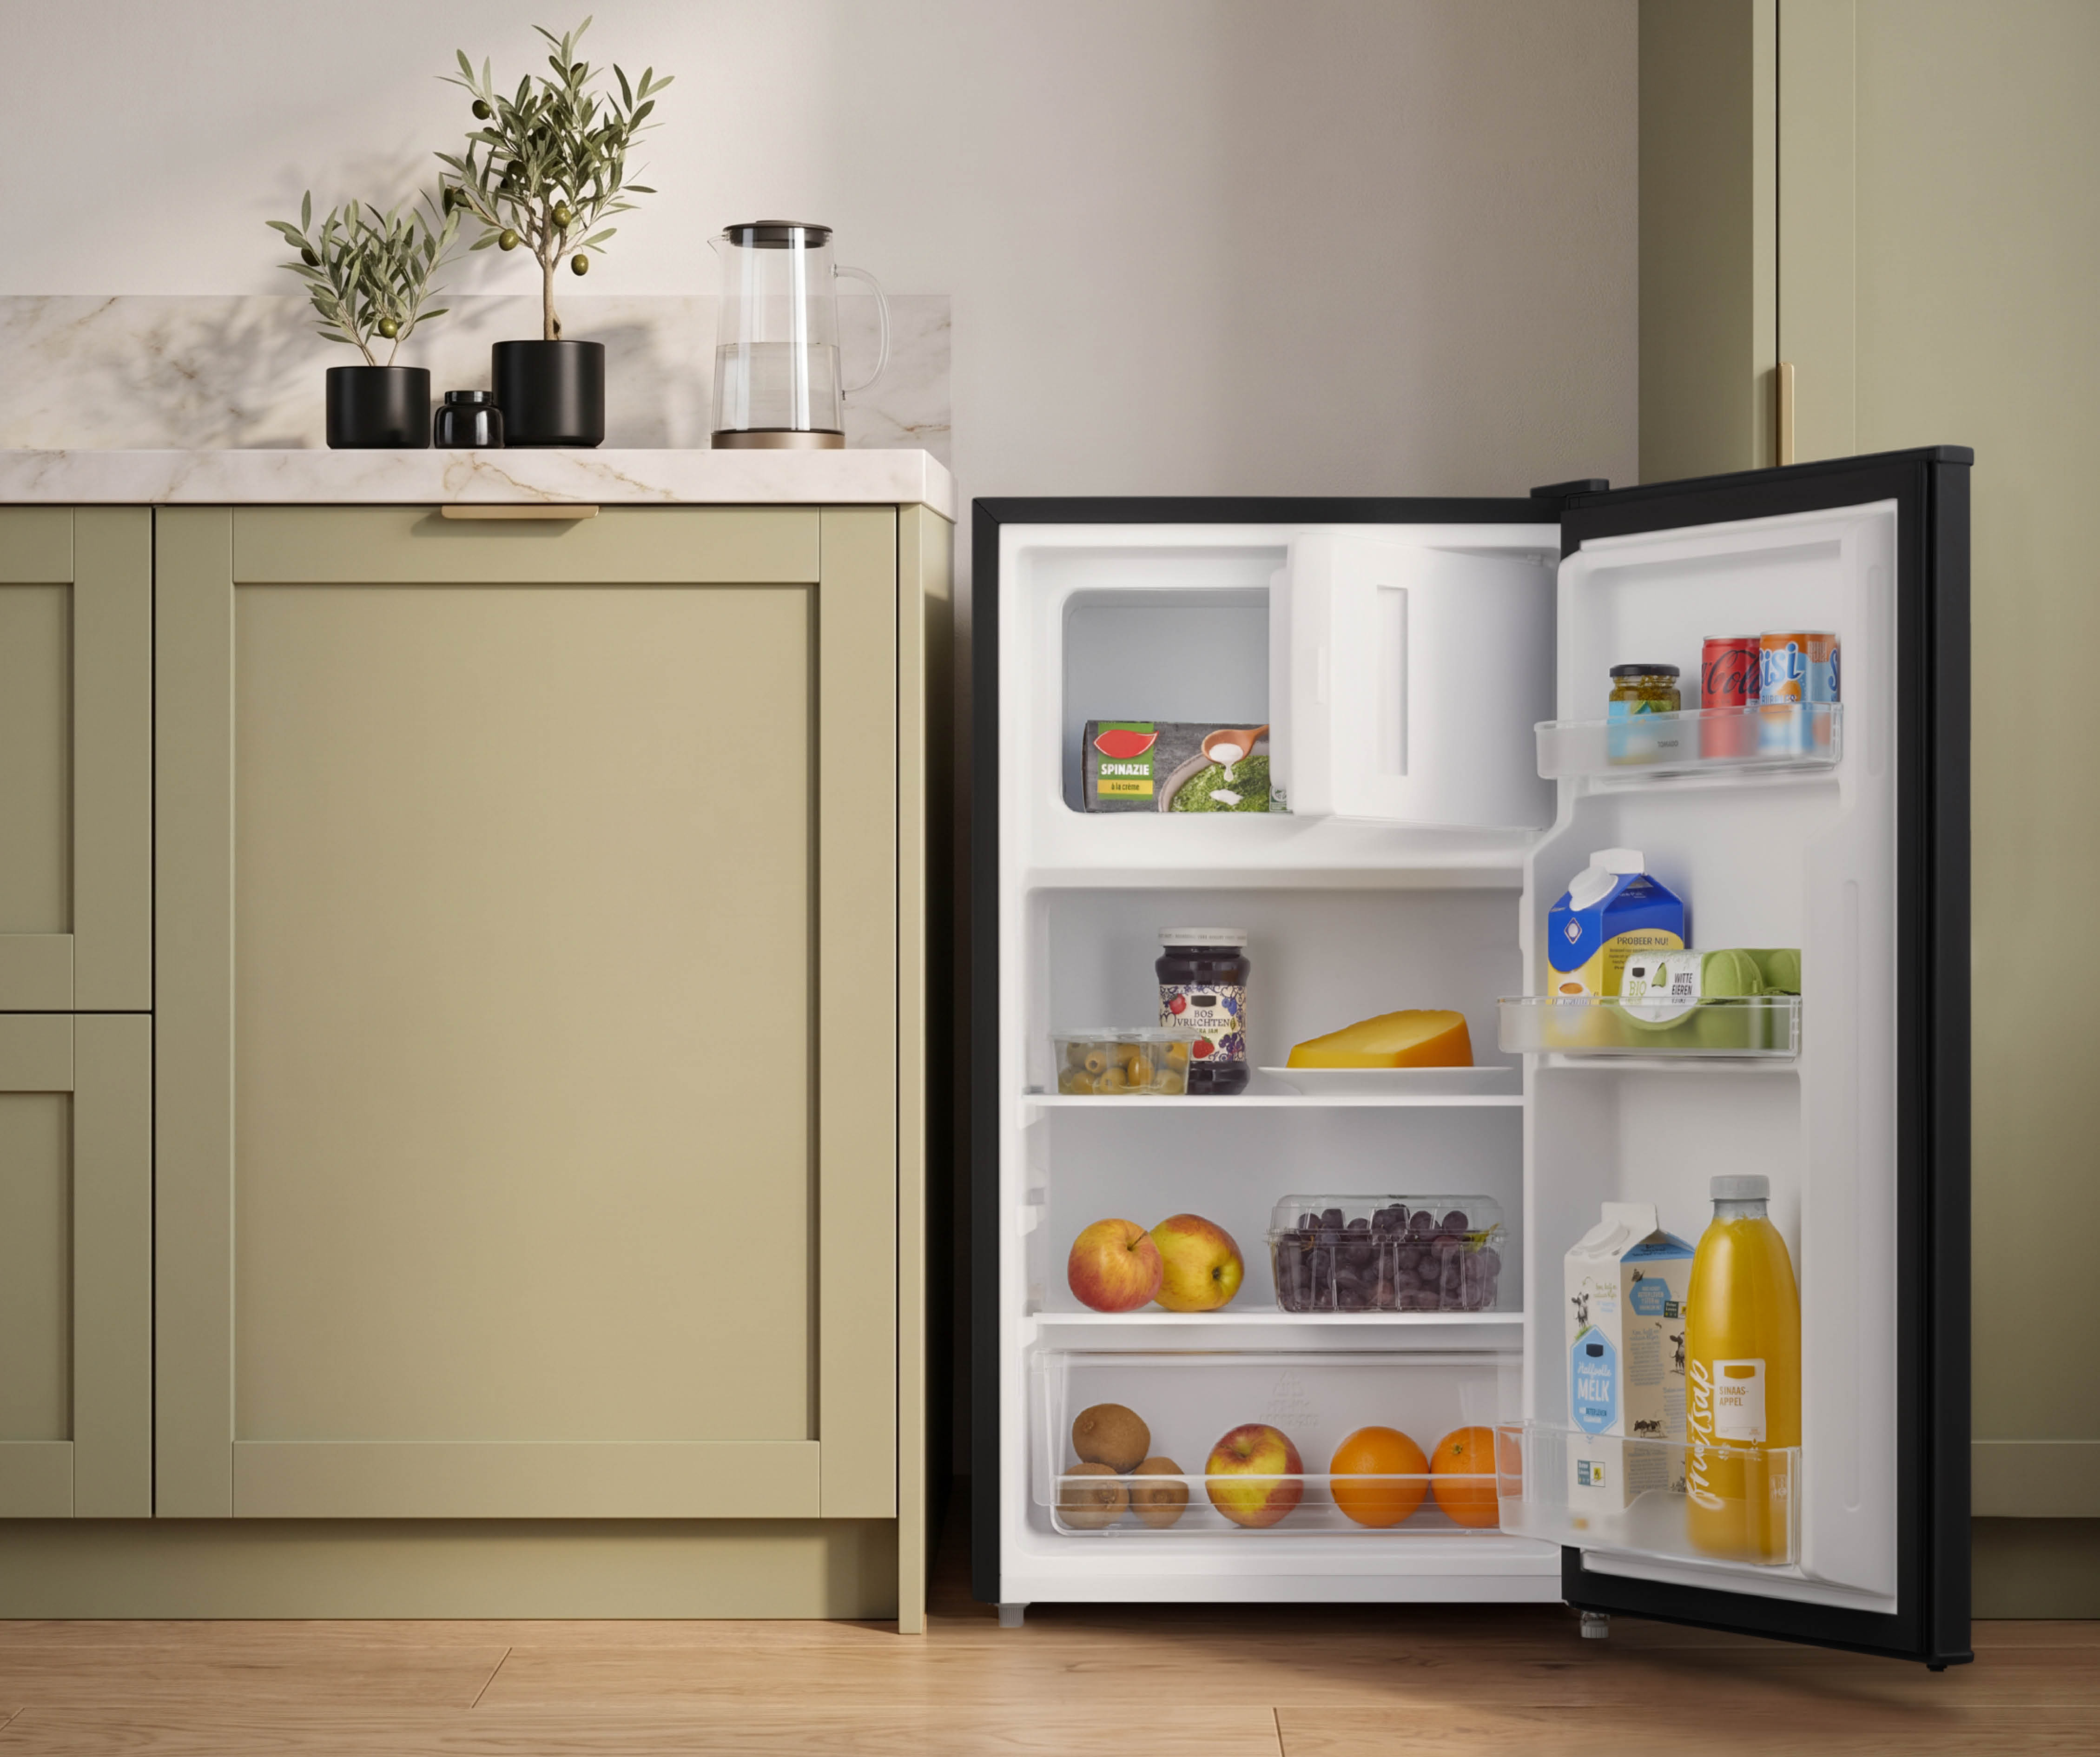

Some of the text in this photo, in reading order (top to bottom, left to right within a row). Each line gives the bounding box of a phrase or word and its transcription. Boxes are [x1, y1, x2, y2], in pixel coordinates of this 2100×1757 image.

[1101, 764, 1149, 775] SPINAZIE
[1674, 973, 1693, 984] WITTE
[1629, 981, 1647, 996] BIO
[1671, 984, 1692, 995] EIEREN
[1177, 1018, 1230, 1027] VRUCHTEN
[1578, 1378, 1610, 1402] MELK
[1718, 1397, 1743, 1406] APPEL
